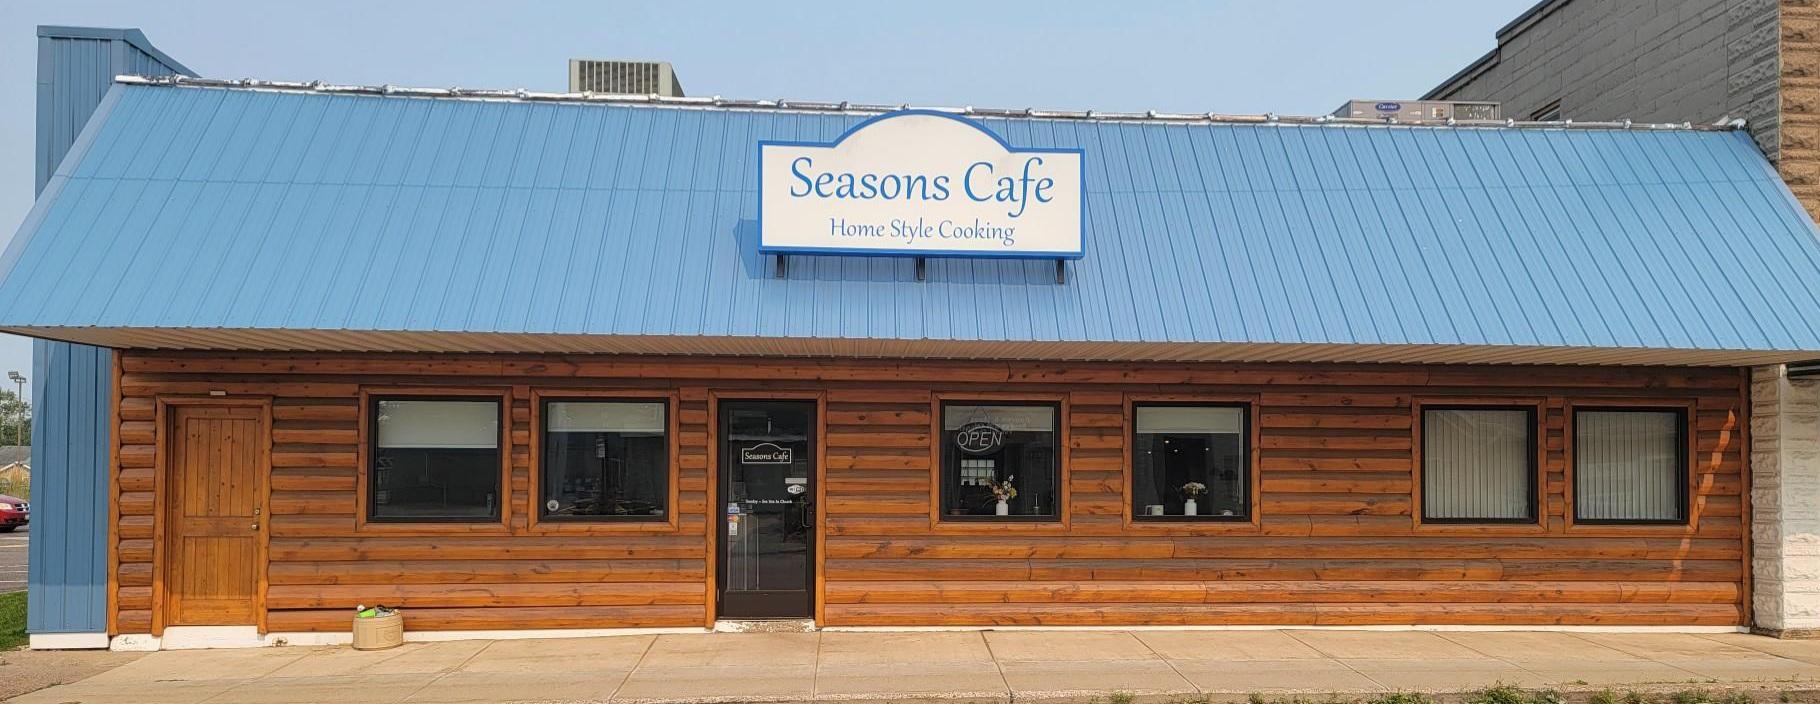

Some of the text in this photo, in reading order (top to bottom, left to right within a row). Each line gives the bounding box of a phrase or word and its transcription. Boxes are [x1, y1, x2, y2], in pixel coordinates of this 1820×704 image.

[790, 156, 1054, 218] Seasons Cafe
[829, 217, 1016, 246] Home Style Cooking
[957, 431, 1002, 447] OPEN
[744, 450, 789, 462] Seasons Cafe
